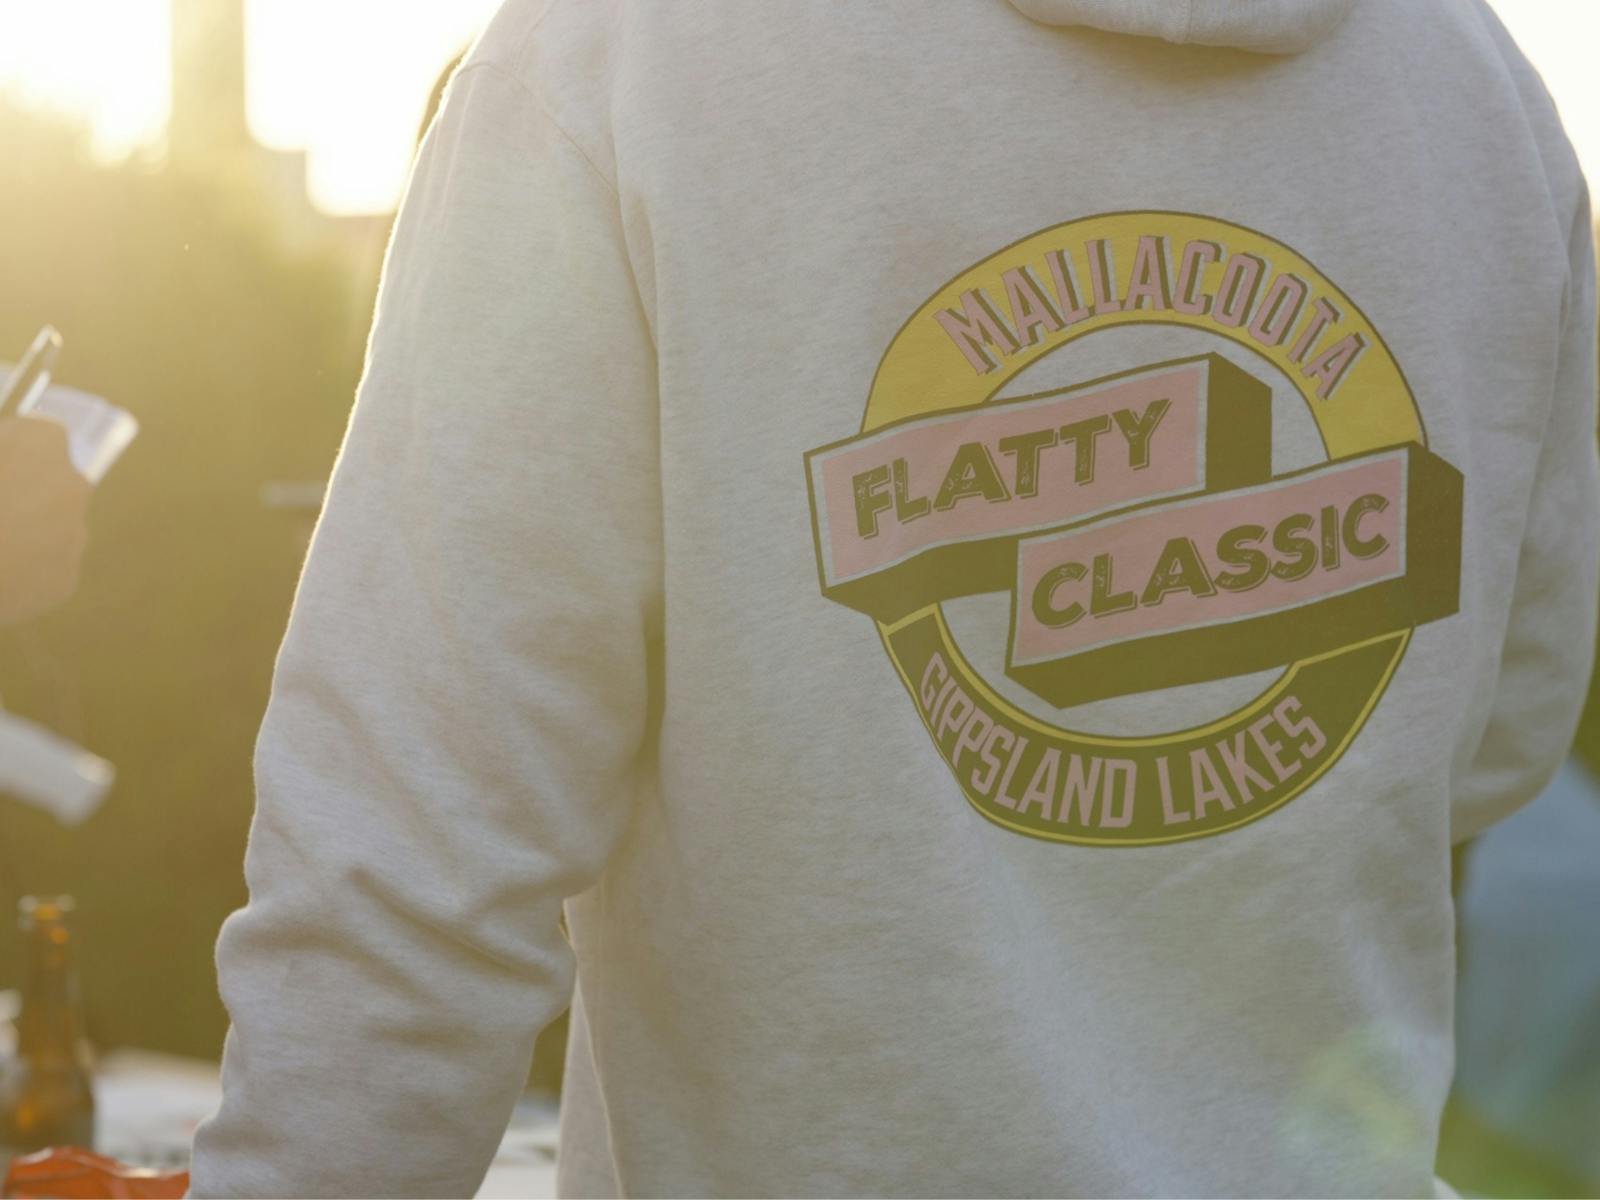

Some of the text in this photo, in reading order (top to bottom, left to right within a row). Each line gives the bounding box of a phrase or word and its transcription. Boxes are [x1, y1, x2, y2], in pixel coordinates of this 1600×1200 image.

[932, 236, 1369, 400] MALLACOOTA
[852, 398, 1172, 538] FLATTY
[1031, 493, 1390, 628] CLASSIC
[919, 652, 1327, 828] GIPPSLAND LAKES
